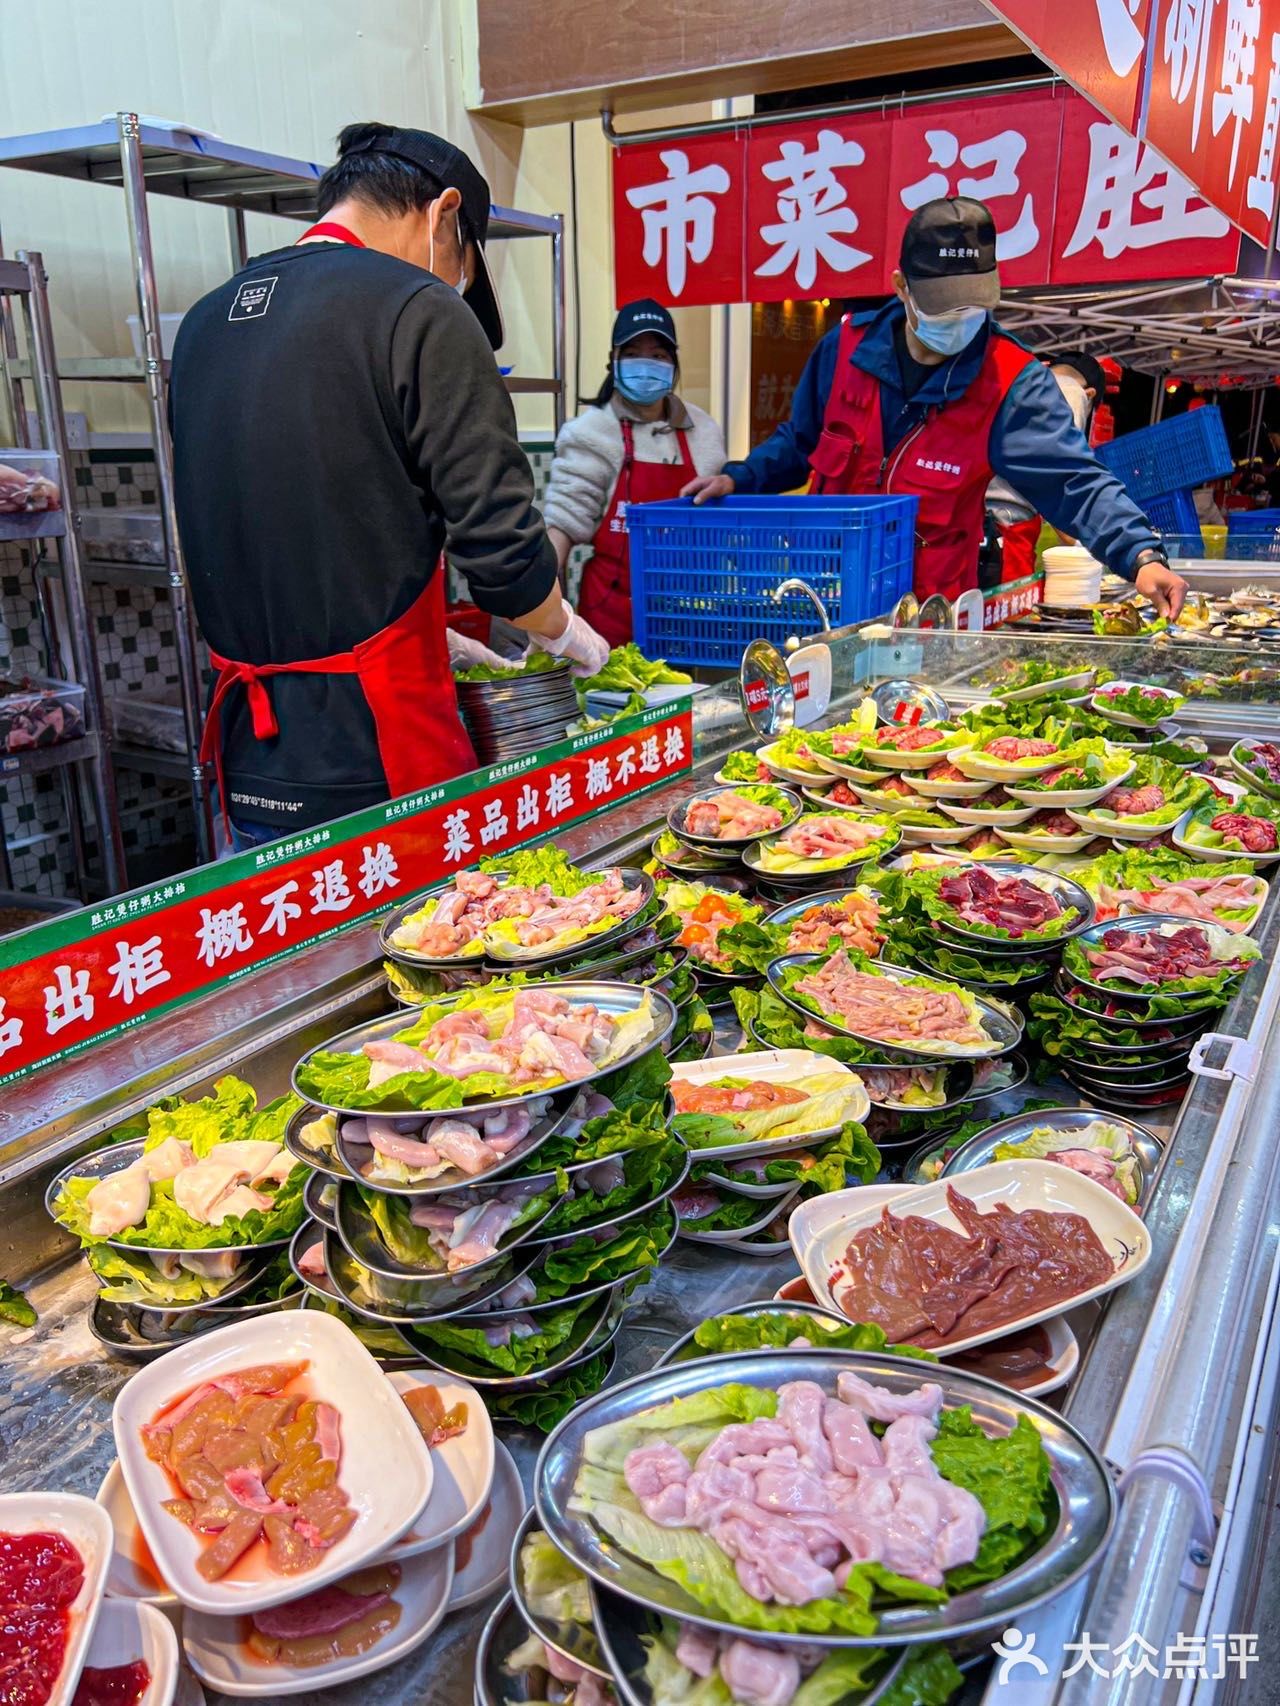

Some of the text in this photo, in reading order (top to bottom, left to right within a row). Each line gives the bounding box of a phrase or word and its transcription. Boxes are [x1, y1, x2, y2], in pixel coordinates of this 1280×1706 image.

[195, 842, 401, 968] 概不退换
[442, 772, 575, 862] 菜品出柜
[585, 725, 685, 800] 概不退换
[256, 830, 331, 865] 胜记煲仔粥大排档
[91, 882, 186, 926] 胜记煲仔粥大排档
